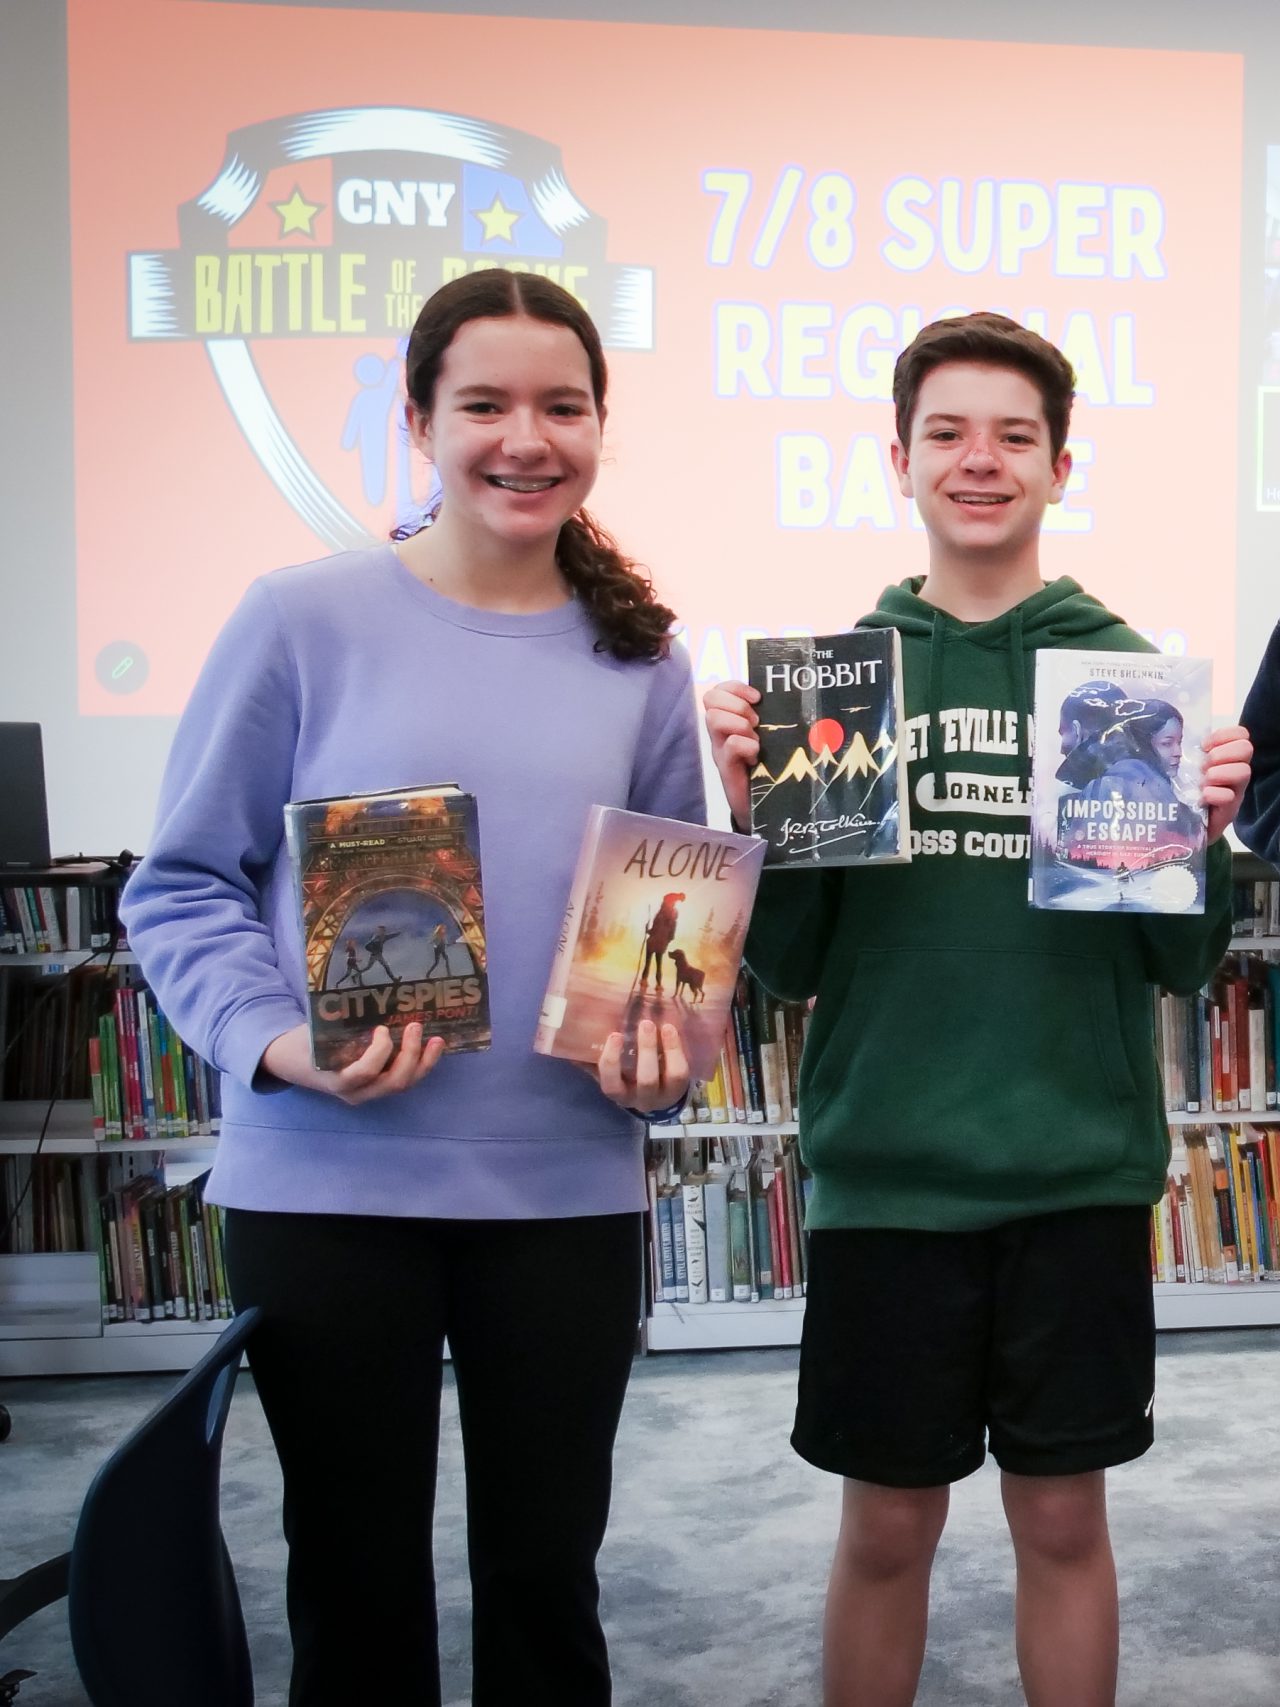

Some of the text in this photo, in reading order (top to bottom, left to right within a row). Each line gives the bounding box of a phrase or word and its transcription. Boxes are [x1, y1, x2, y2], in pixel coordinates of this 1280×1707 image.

[337, 177, 456, 227] CNY
[703, 166, 1166, 279] 7/8 SUPER
[195, 253, 367, 334] BATTLE
[391, 259, 417, 294] OF
[715, 302, 1156, 406] REGAL
[777, 432, 1094, 533] BAE
[816, 650, 834, 659] THE
[765, 660, 882, 693] HOBBIT
[934, 782, 1031, 804] ORNET
[1066, 799, 1179, 822] IMPOSSIBLE
[339, 838, 385, 848] MUST-READ
[910, 830, 957, 855] OSS
[1086, 823, 1157, 843] ESCAPE
[624, 839, 737, 881] ALONE
[318, 978, 482, 1022] CITY SPIES
[436, 1006, 480, 1021] PONTI
